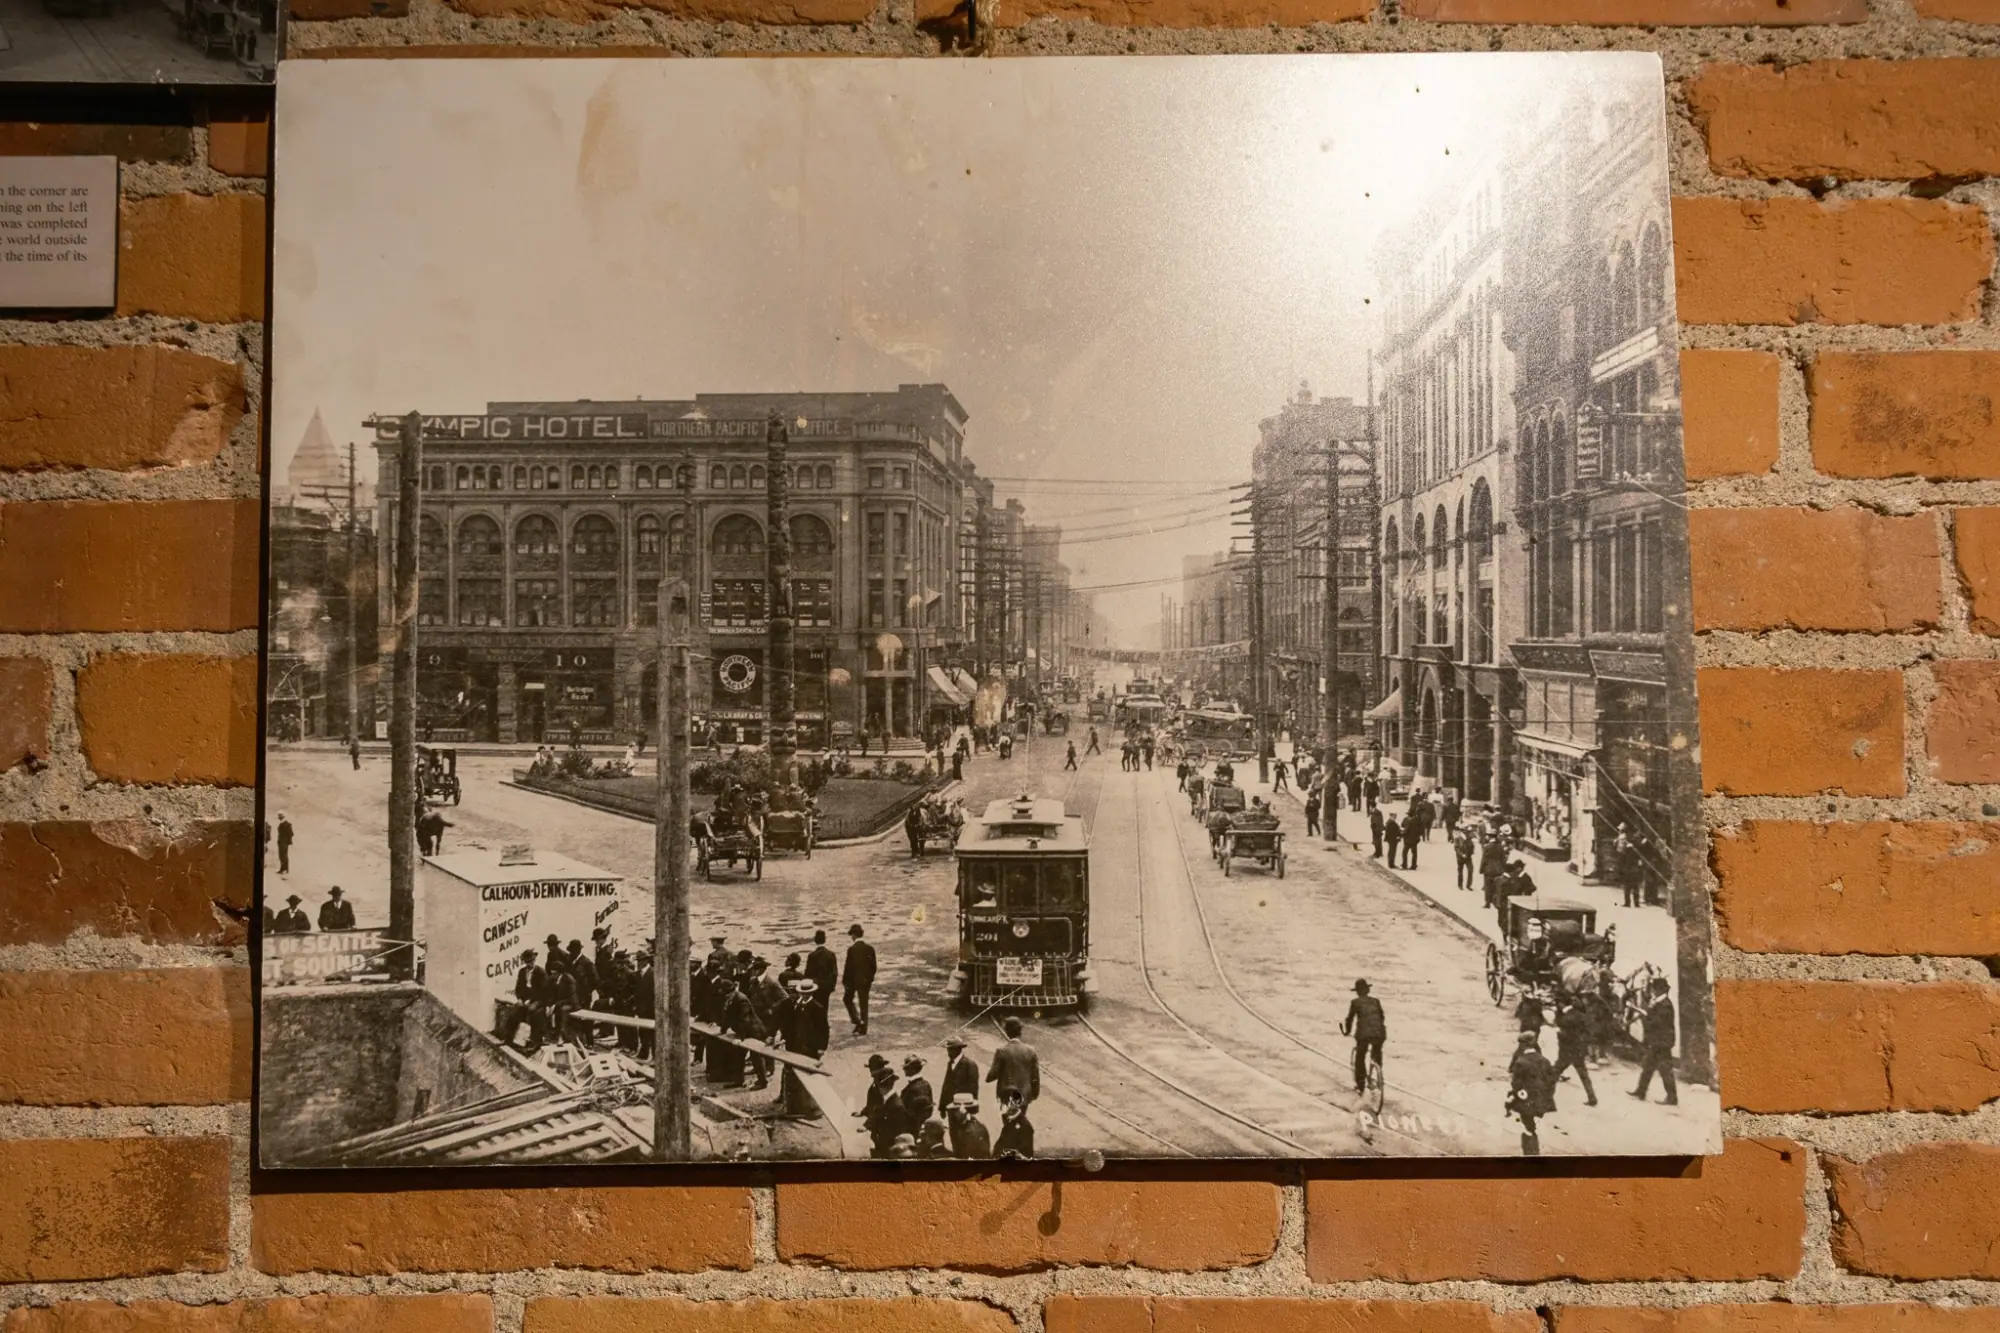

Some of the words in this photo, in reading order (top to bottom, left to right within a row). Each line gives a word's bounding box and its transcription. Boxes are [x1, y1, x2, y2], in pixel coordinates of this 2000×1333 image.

[8, 185, 26, 196] the
[29, 188, 67, 196] corner
[70, 188, 88, 196] are
[26, 204, 42, 212] on
[46, 202, 64, 212] the
[69, 201, 88, 212] left
[1, 221, 22, 229] was
[27, 218, 88, 231] completed
[7, 234, 41, 245] world
[45, 234, 88, 245] outside
[5, 250, 24, 261] the
[27, 251, 54, 261] time
[57, 250, 70, 261] of
[73, 251, 88, 261] its
[379, 416, 511, 438] OYMPIC
[654, 421, 712, 437] NORTHERN
[715, 421, 759, 437] PACIFIC
[722, 676, 753, 689] PACIFIC
[482, 882, 568, 901] CALHOUN-DENNY
[483, 911, 528, 943] CAWSEY
[302, 931, 382, 954] SEATTLE
[499, 935, 520, 953] AND
[486, 955, 522, 978] CARN
